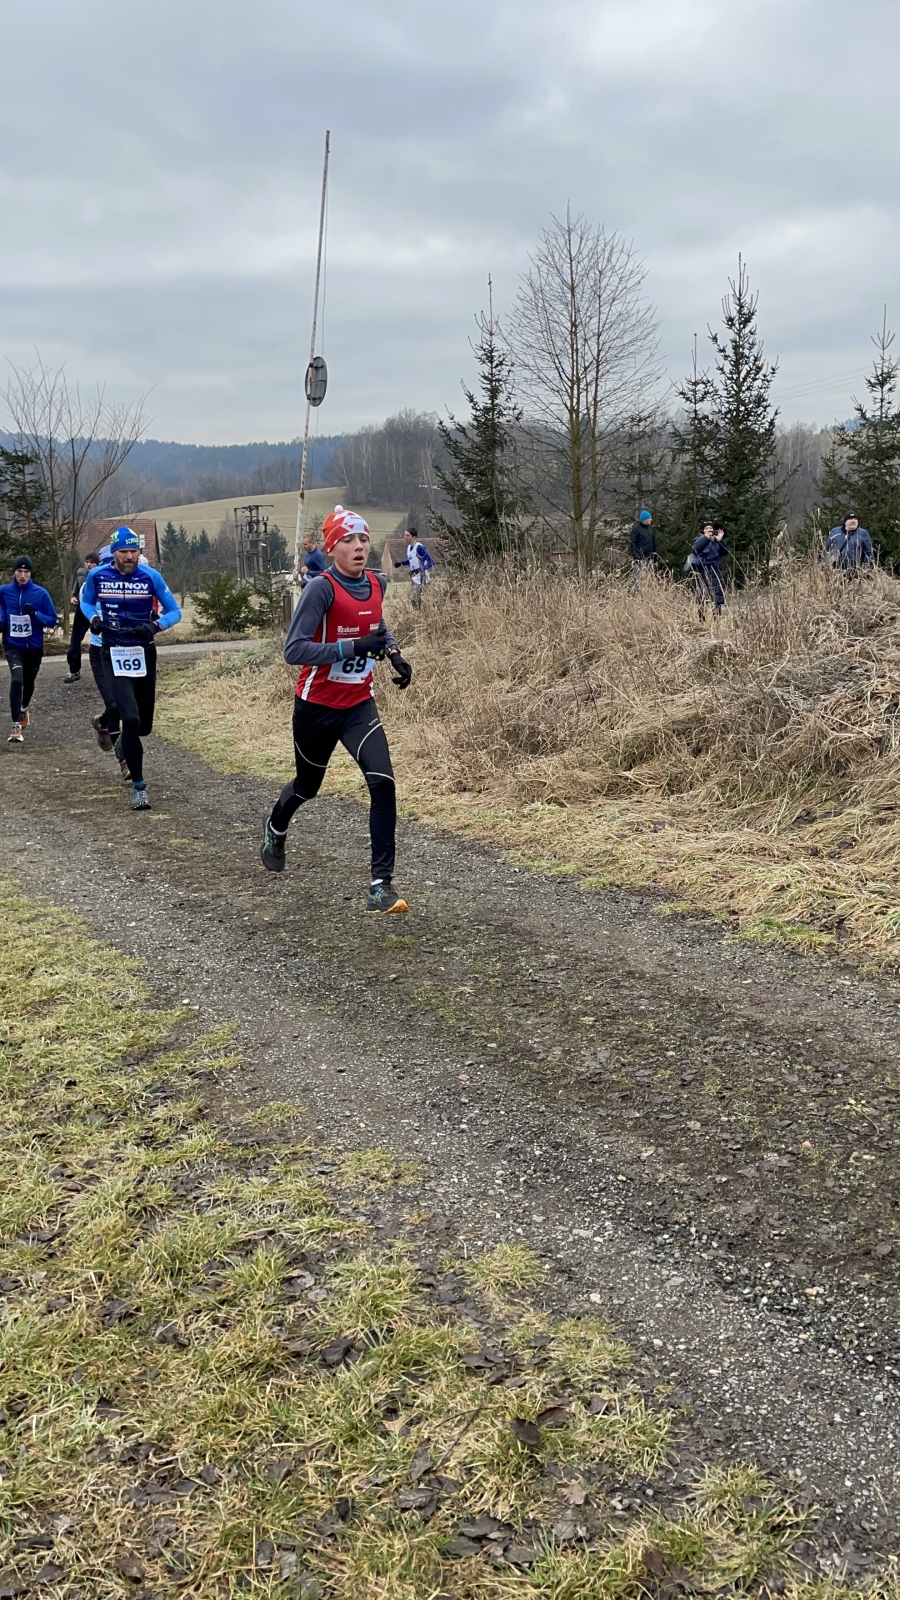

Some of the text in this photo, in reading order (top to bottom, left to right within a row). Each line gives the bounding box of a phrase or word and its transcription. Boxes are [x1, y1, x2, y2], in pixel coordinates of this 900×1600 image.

[99, 581, 149, 590] TRUTNOV
[11, 623, 31, 633] 282
[115, 658, 142, 671] 169
[342, 656, 367, 673] 69
